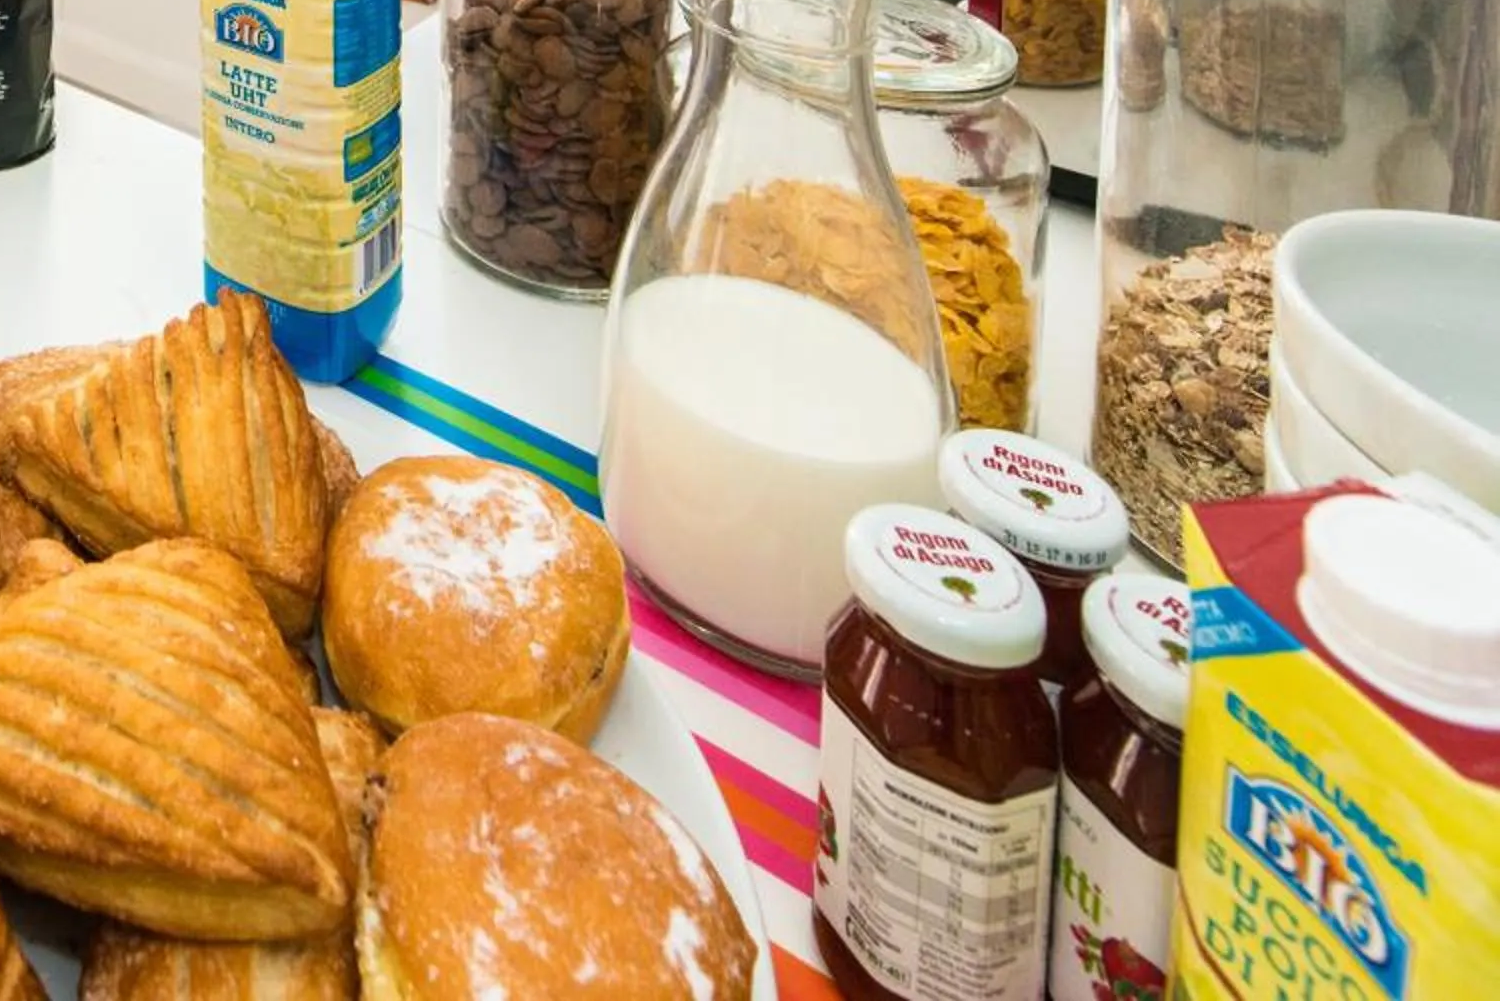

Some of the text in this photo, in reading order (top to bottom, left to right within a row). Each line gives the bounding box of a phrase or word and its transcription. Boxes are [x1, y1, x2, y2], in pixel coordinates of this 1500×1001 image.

[223, 17, 276, 54] BIO
[220, 60, 278, 94] LATTE
[230, 80, 268, 108] UHT
[224, 115, 276, 145] INTERO
[982, 457, 1084, 496] di Asiago
[993, 444, 1067, 477] Rigoni
[893, 525, 970, 552] Rigoni
[892, 544, 995, 574] di Asiago
[1136, 600, 1161, 618] di
[1224, 689, 1429, 898] ESSELUNGA
[1058, 856, 1102, 925] tti
[1245, 794, 1390, 966] BIO
[1204, 916, 1254, 987] DI
